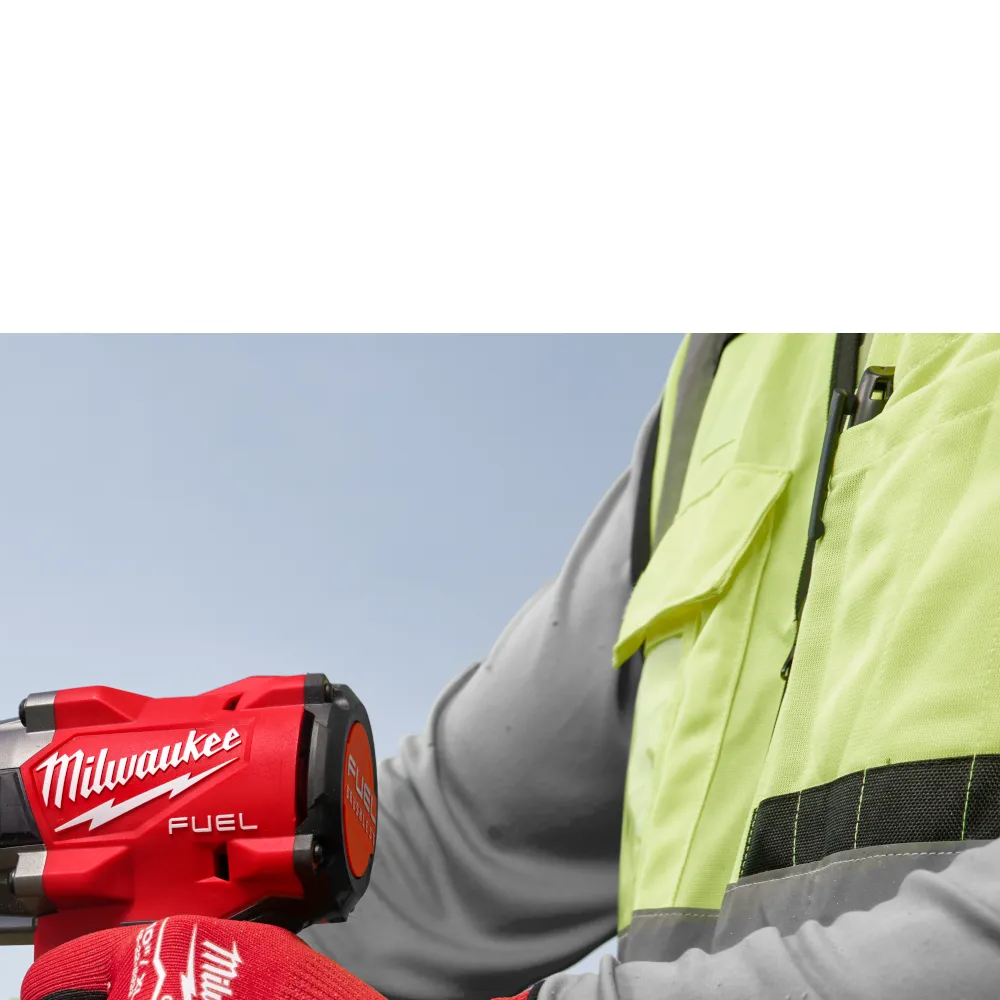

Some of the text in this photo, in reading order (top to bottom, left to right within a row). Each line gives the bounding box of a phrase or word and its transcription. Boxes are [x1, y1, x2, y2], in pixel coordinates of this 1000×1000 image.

[36, 728, 242, 809] Milwaukee
[347, 753, 376, 826] FUEL
[168, 812, 258, 835] FUEL
